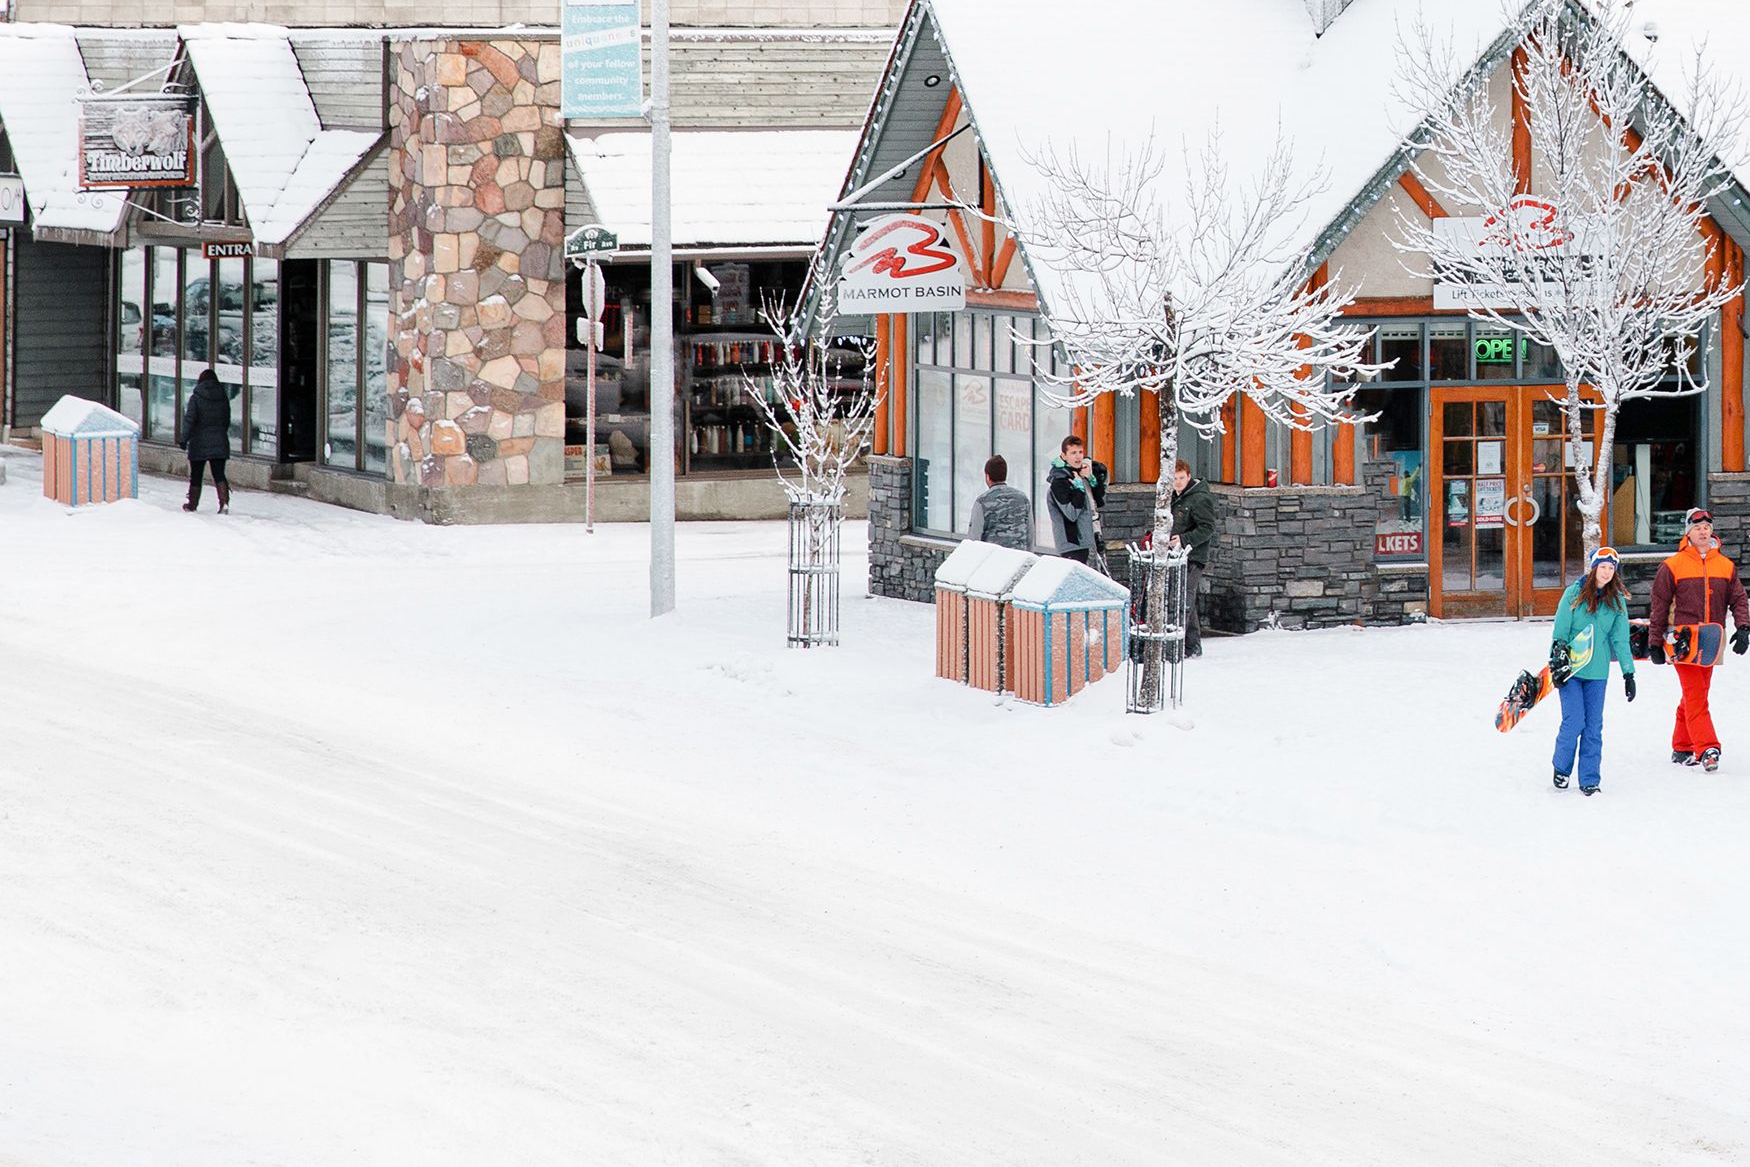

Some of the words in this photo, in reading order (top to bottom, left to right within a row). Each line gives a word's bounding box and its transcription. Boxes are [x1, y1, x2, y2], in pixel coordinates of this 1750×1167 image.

[572, 14, 612, 23] Embrace
[614, 14, 630, 23] the
[566, 29, 636, 47] uniquenes
[567, 59, 579, 69] of
[580, 61, 604, 71] your
[604, 58, 636, 68] fellow
[574, 75, 630, 86] community
[86, 151, 187, 172] Timberwolf
[208, 244, 252, 255] ENTRA
[583, 240, 596, 250] Fir
[843, 287, 911, 300] MARMOT
[915, 286, 961, 298] BASIN
[1452, 289, 1468, 299] Lift
[1000, 411, 1029, 434] CARD
[1378, 535, 1418, 552] KETS
